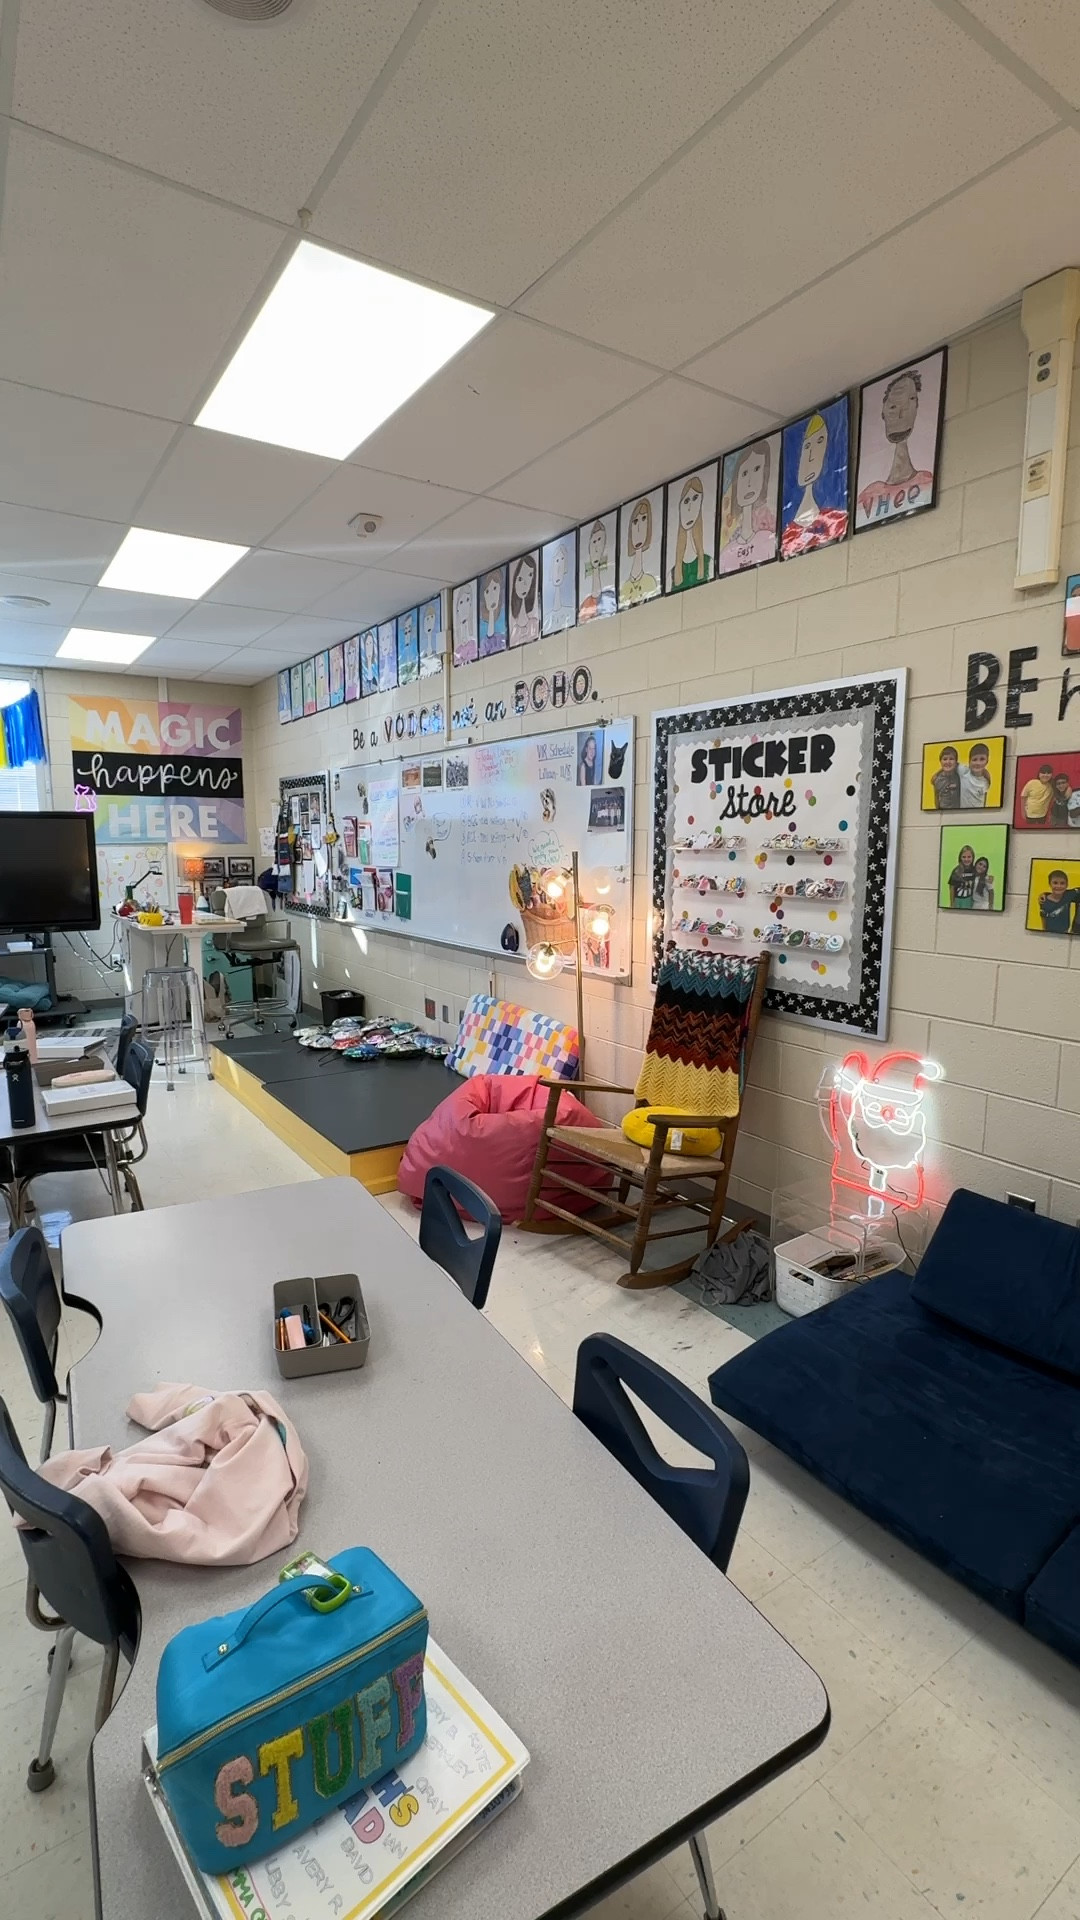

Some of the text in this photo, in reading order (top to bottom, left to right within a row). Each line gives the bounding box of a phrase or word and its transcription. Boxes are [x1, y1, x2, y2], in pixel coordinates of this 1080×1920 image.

[353, 729, 365, 750] Be
[370, 732, 379, 747] a
[485, 701, 507, 722] an
[511, 666, 599, 716] ECHO.
[964, 646, 1039, 732] BE
[85, 709, 231, 749] MAGIC
[77, 754, 239, 793] happens
[690, 733, 836, 784] STICKER
[108, 804, 219, 839] HERE
[214, 1653, 424, 1848] STUFF
[292, 1845, 334, 1893] AVERY
[340, 1837, 374, 1885] DAVID
